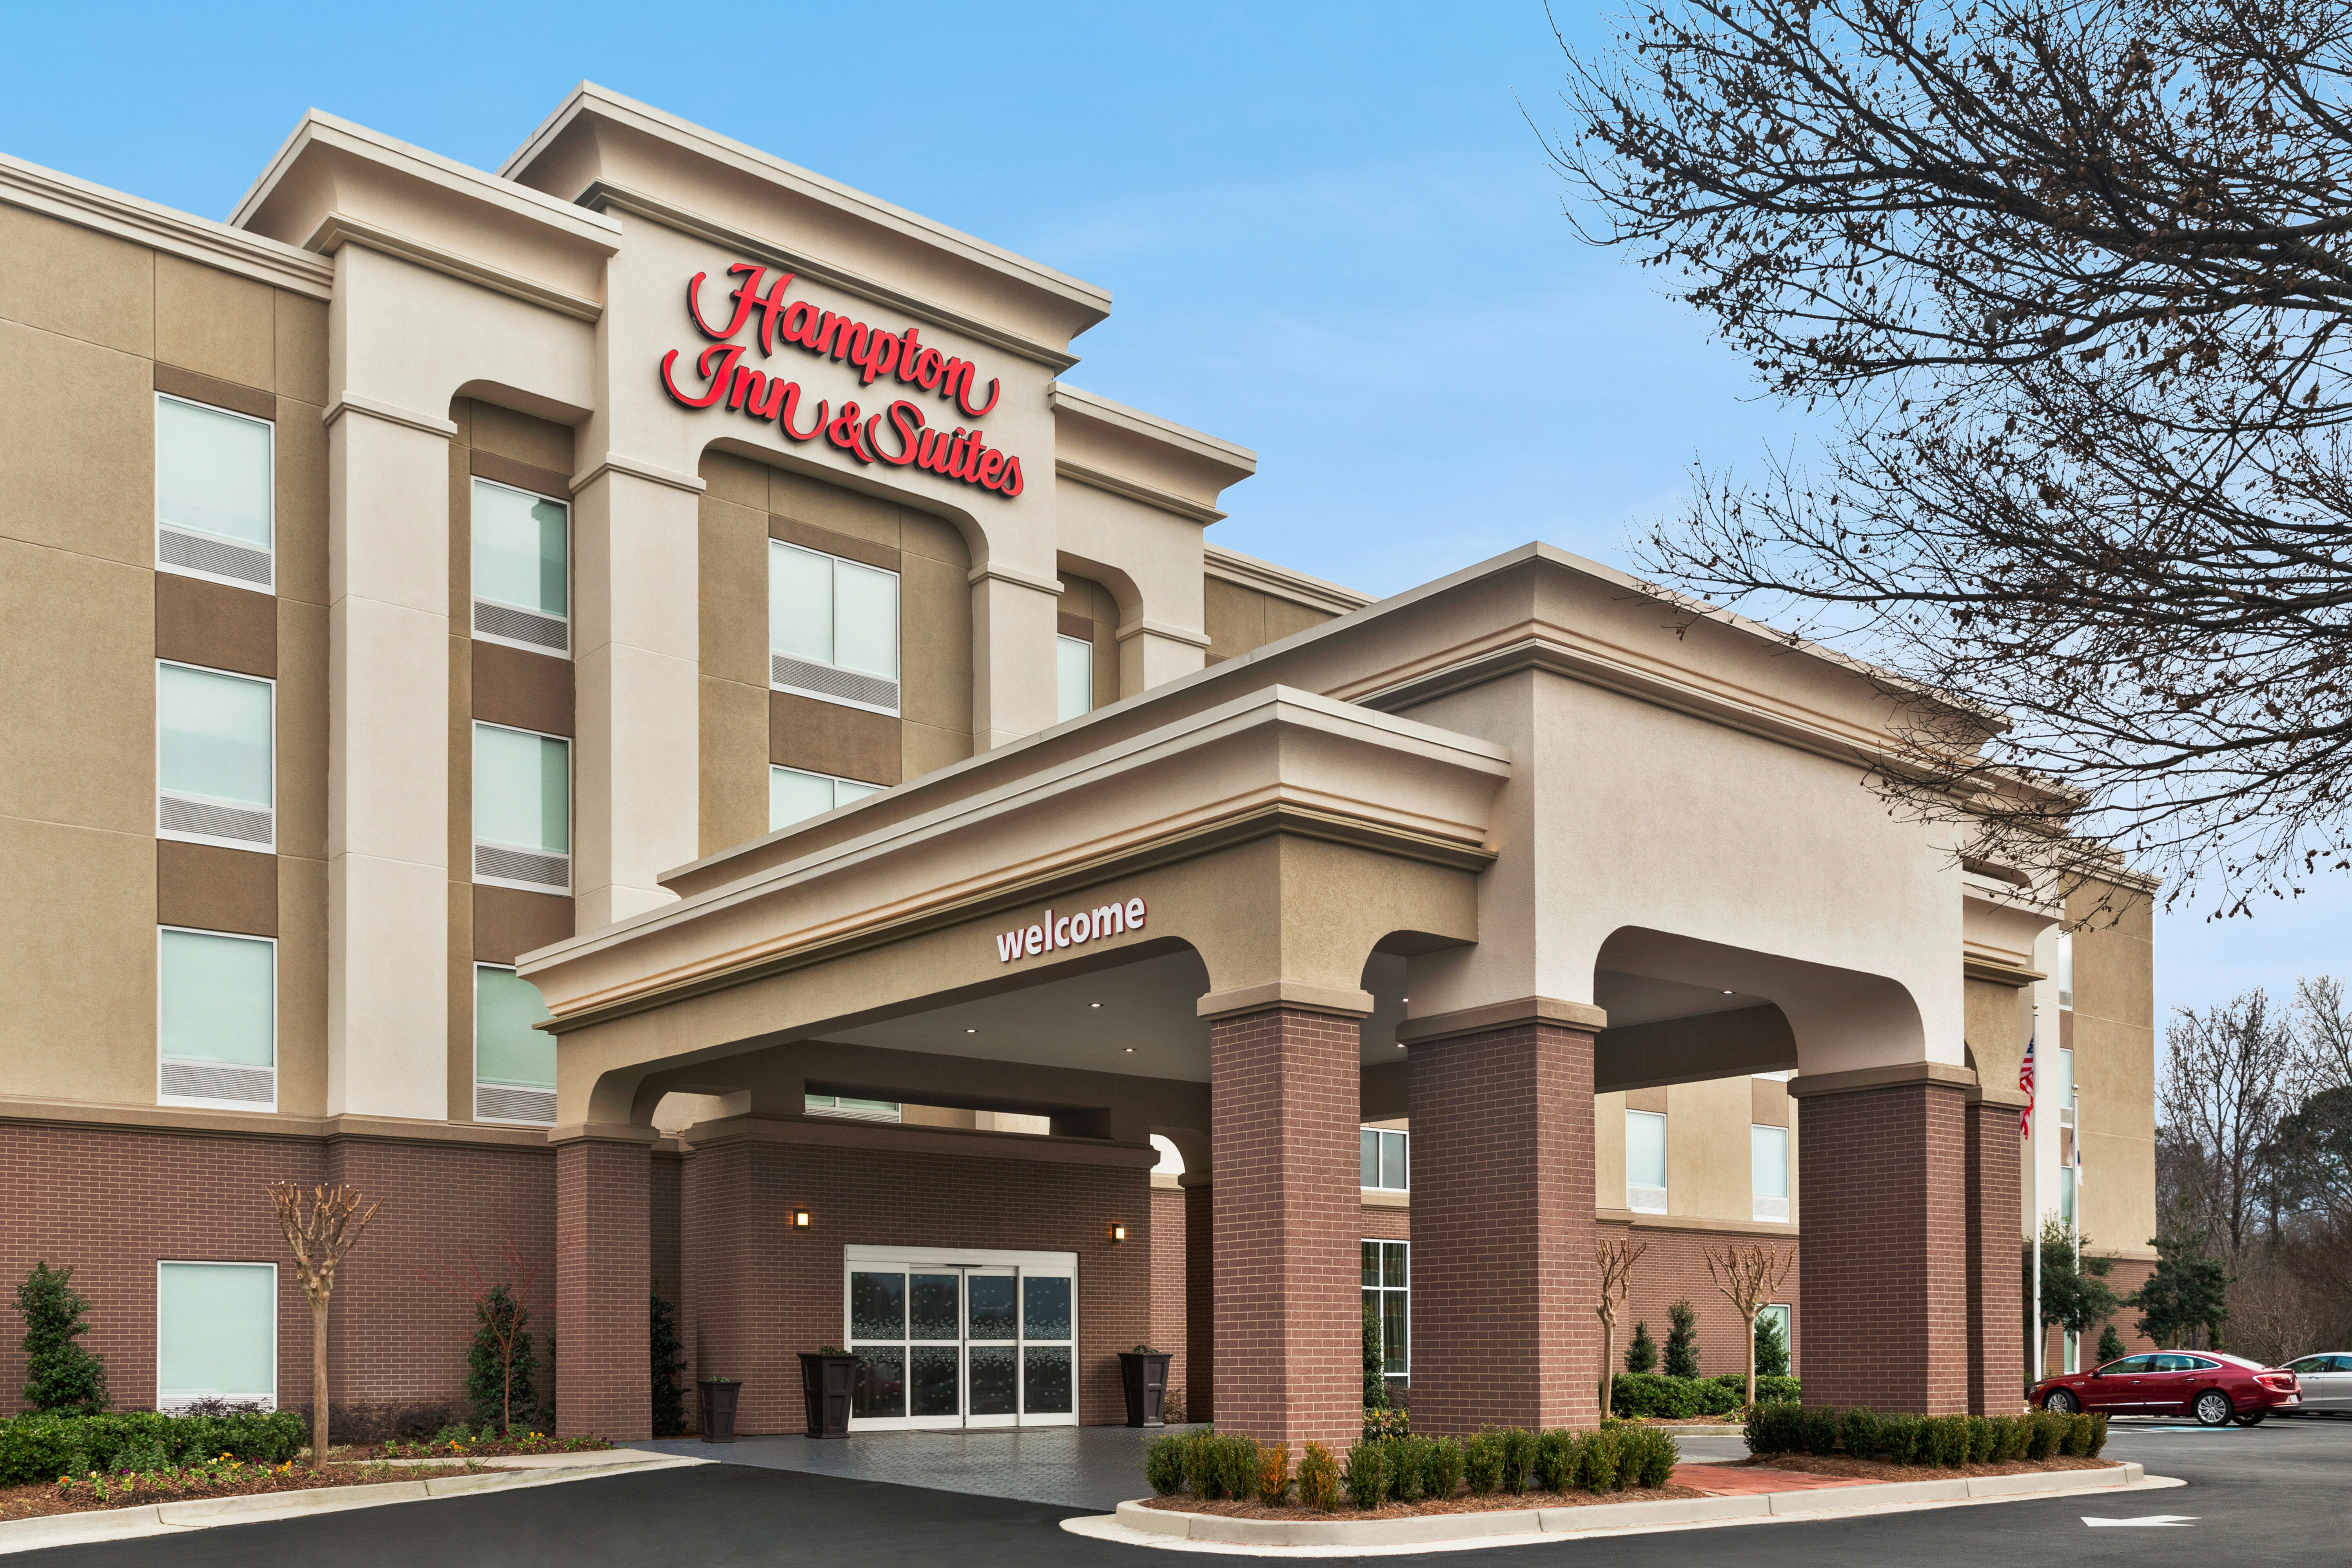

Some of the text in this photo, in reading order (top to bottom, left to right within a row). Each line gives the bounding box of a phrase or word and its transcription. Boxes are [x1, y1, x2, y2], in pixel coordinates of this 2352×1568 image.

[687, 263, 1000, 418] Hampton
[660, 343, 829, 442] Inn
[866, 400, 1024, 498] Suites
[996, 897, 1147, 962] welcome
